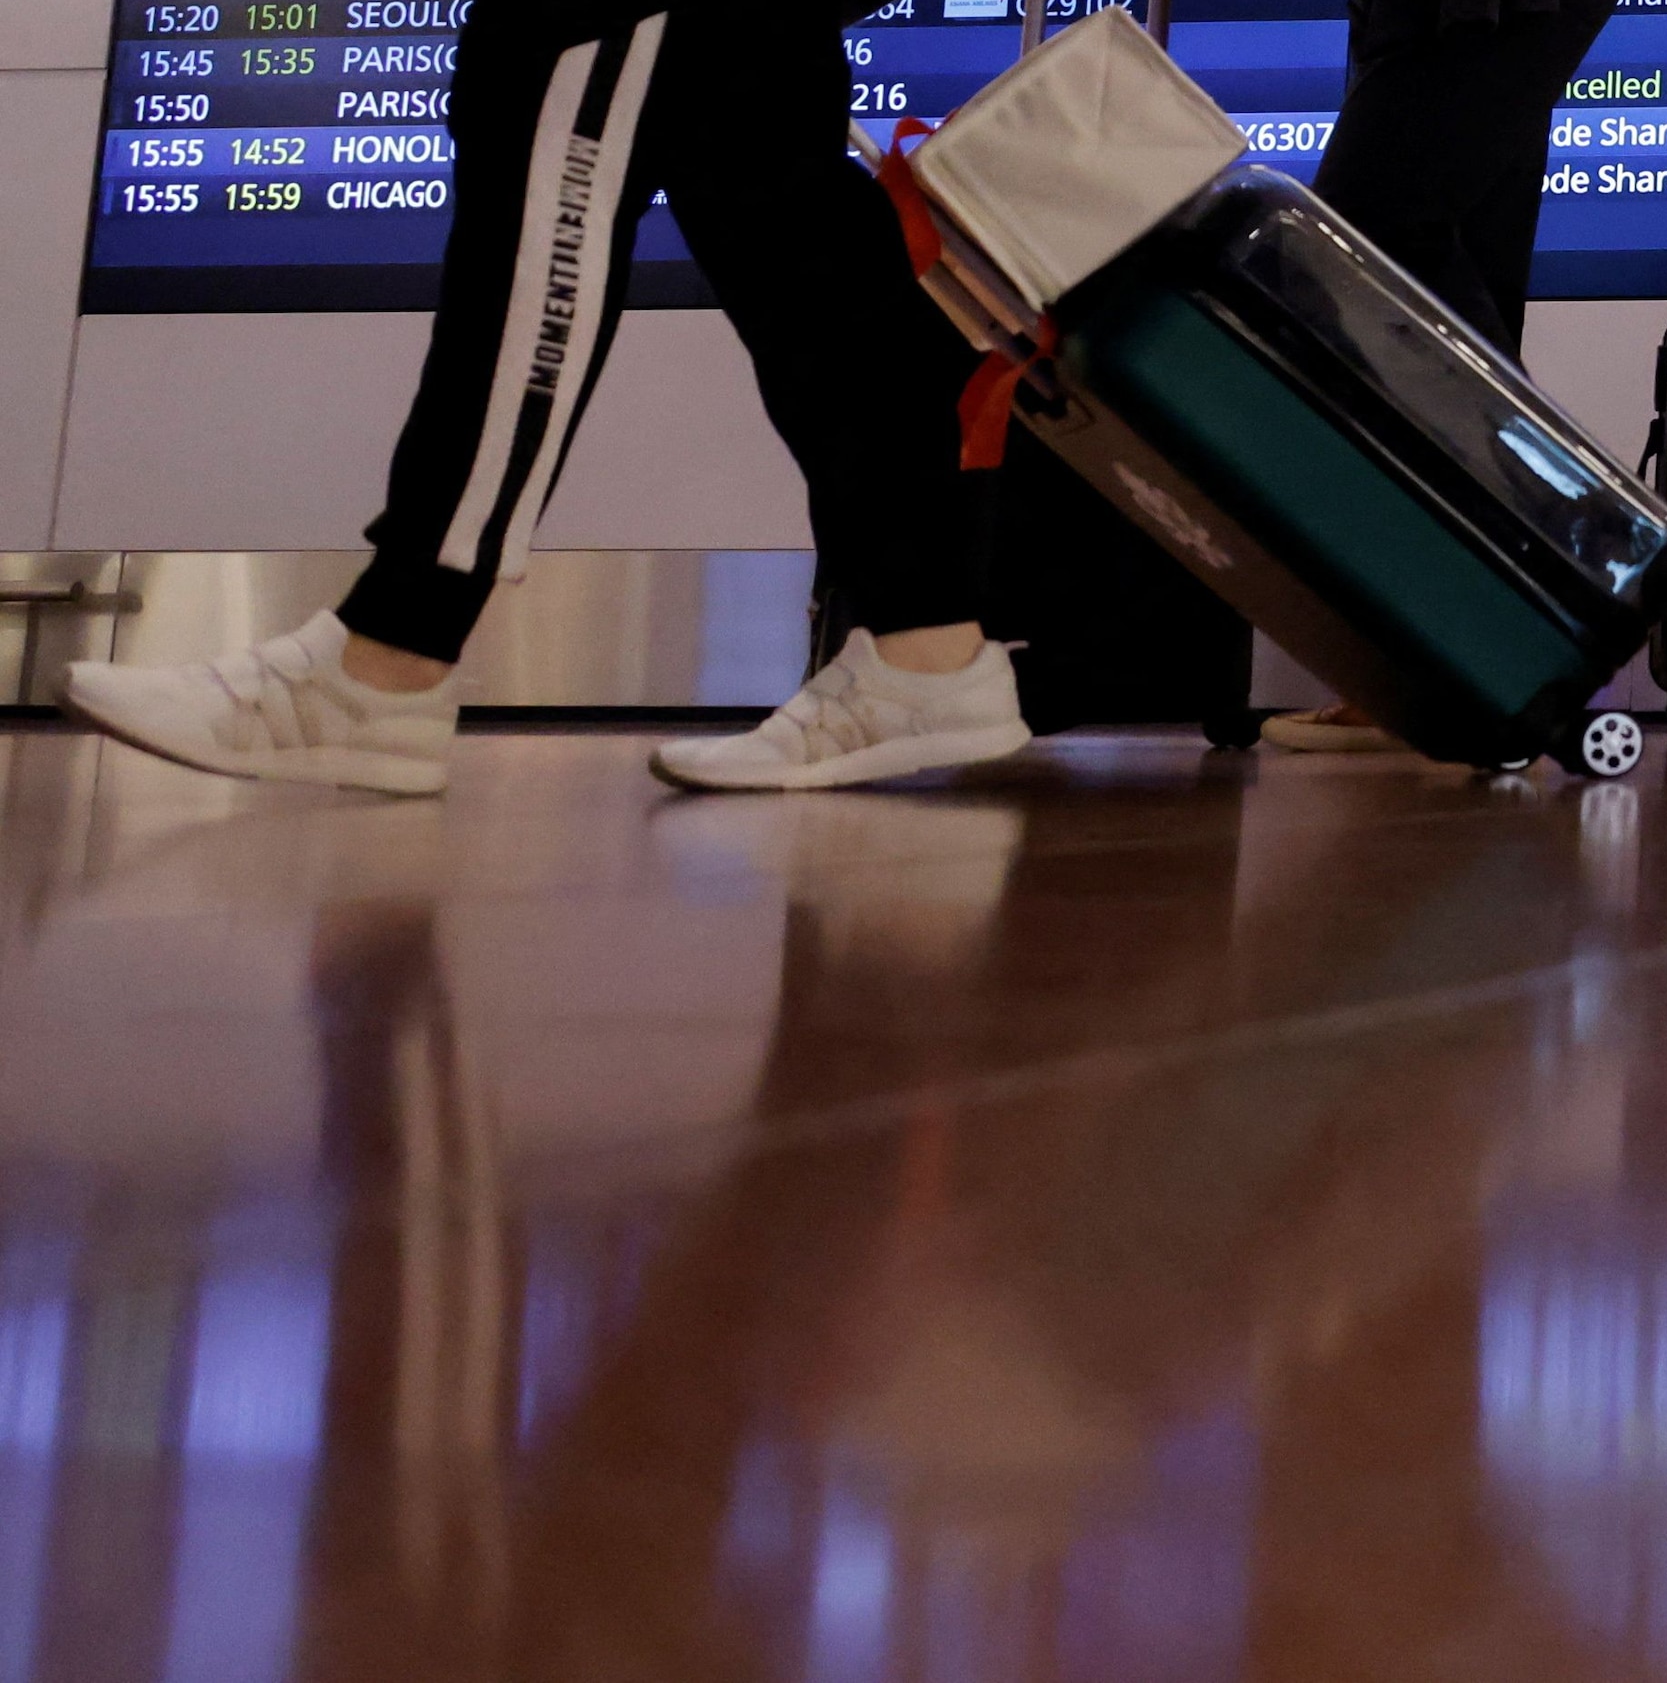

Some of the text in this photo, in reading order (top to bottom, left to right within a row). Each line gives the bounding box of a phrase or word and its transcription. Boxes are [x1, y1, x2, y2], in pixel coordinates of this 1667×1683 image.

[146, 6, 218, 31] 15:20
[248, 4, 316, 29] 15:01
[141, 50, 213, 76] 15:45
[243, 49, 315, 74] 15:35
[136, 95, 208, 121] 15:50
[130, 140, 203, 166] 15:55
[232, 138, 305, 164] 14:52
[333, 136, 454, 163] HONOL
[125, 185, 199, 211] 15:55
[227, 183, 300, 210] 15:59
[328, 180, 446, 209] CHICAGO
